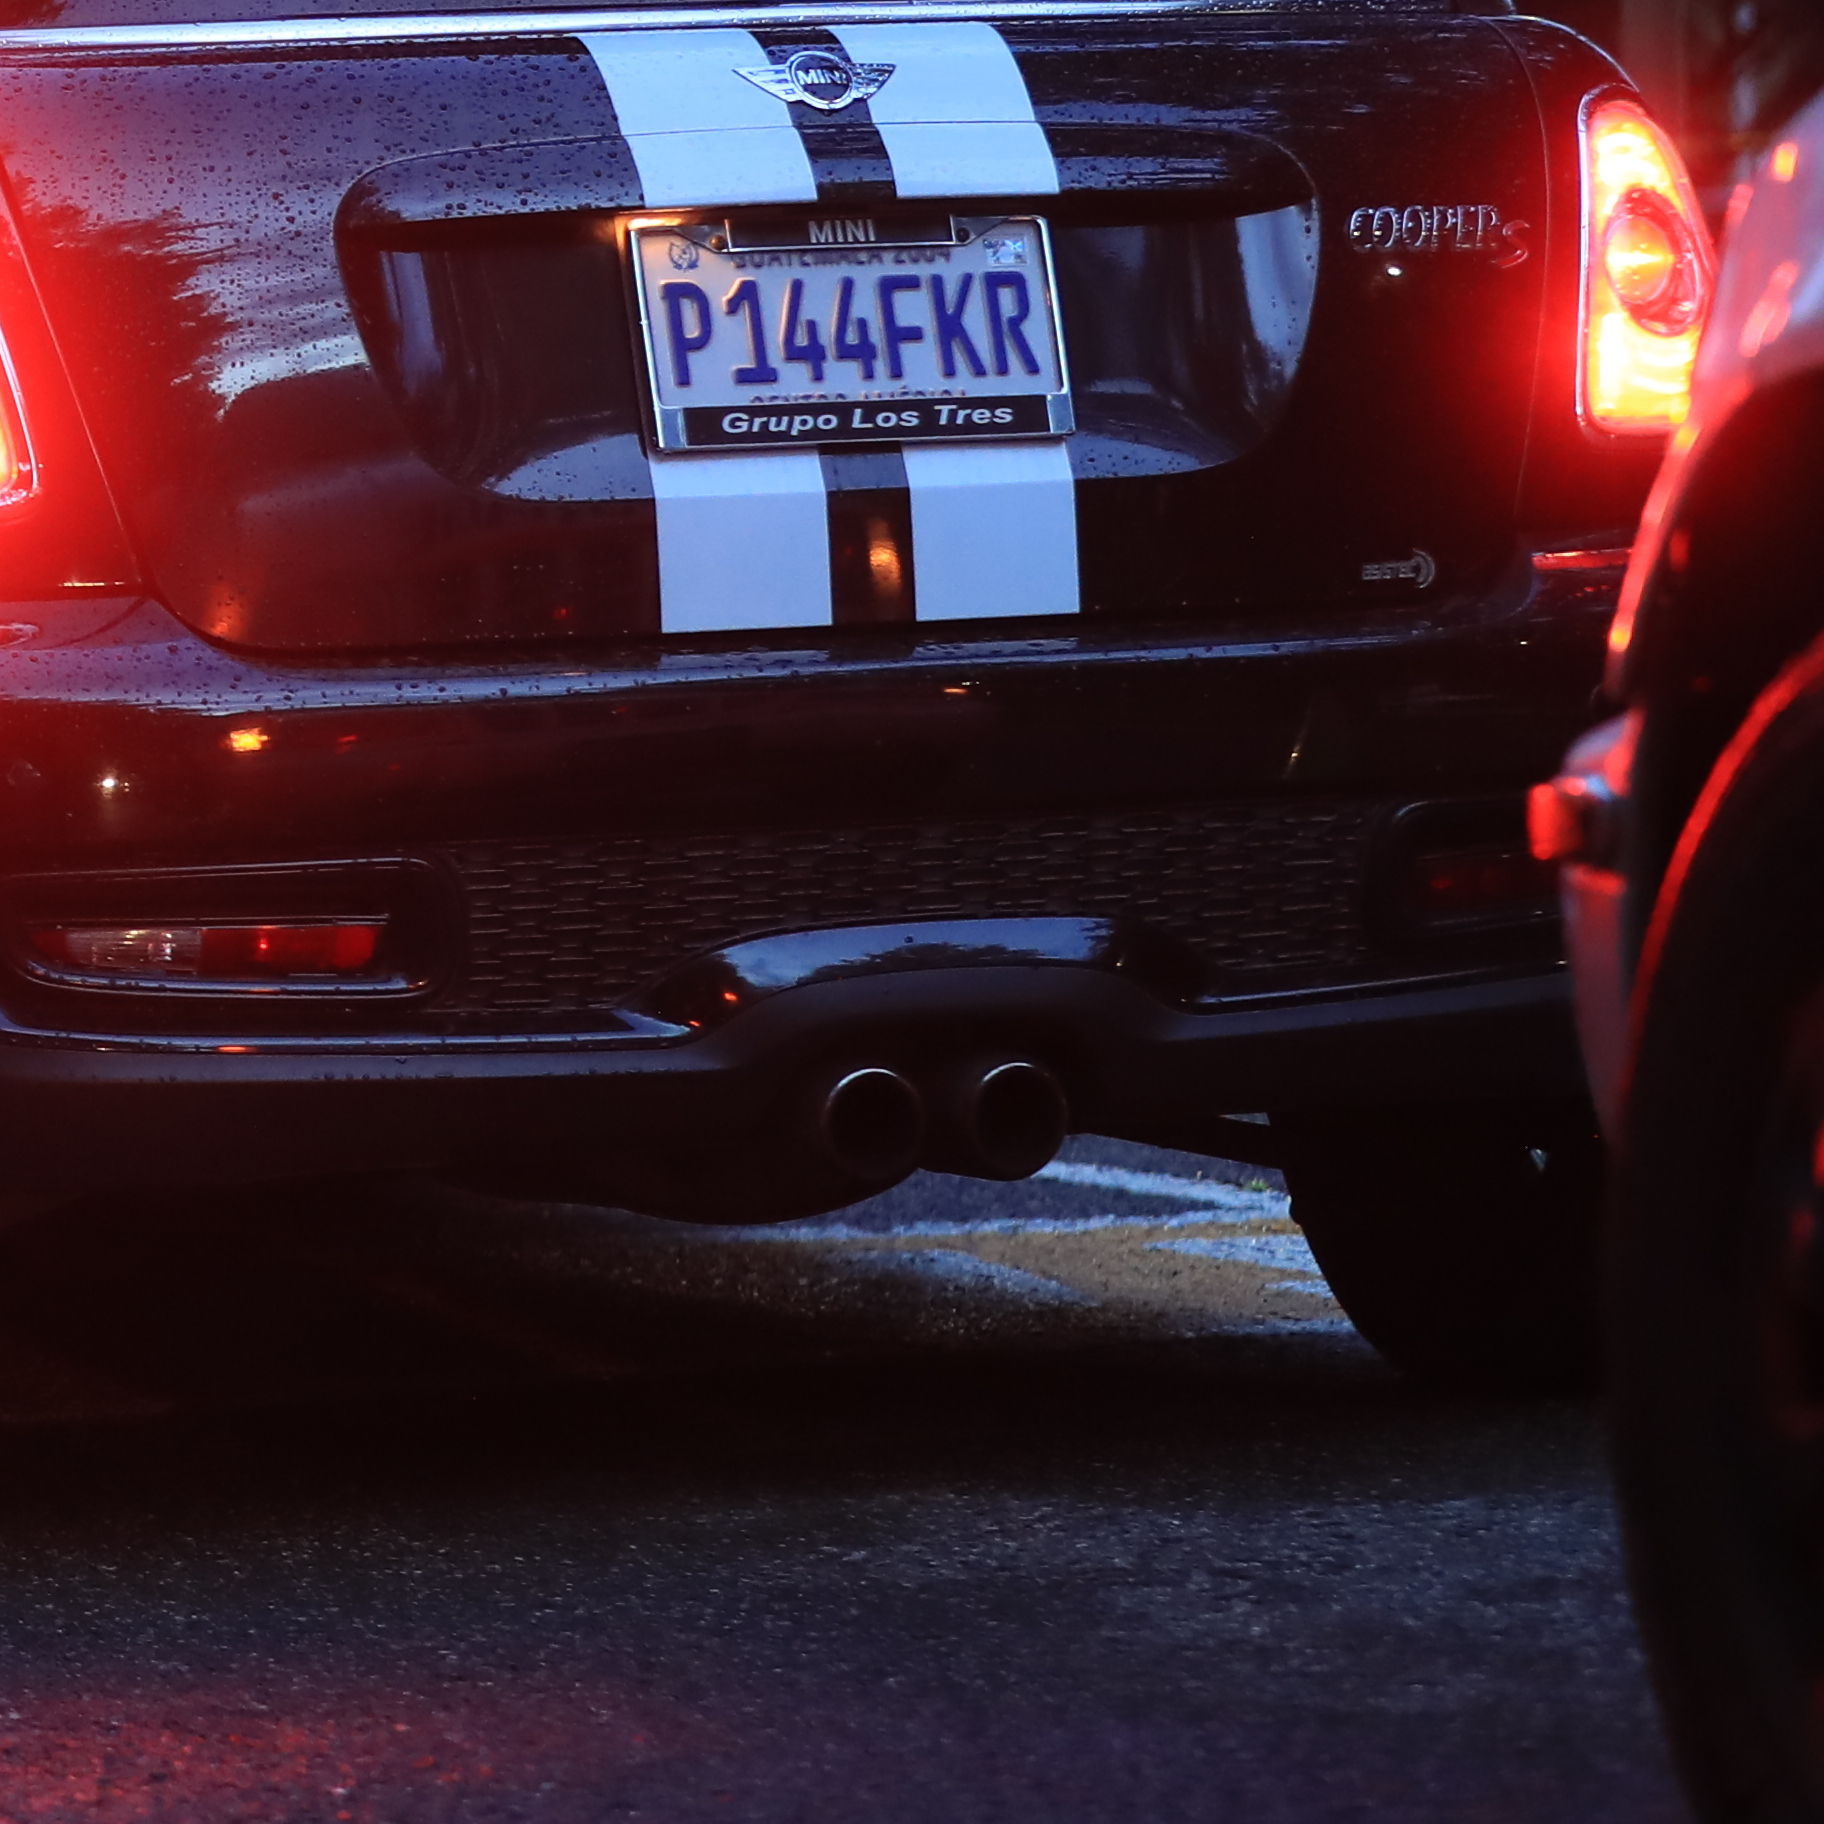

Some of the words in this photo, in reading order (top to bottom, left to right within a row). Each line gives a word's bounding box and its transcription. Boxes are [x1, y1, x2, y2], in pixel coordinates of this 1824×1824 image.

[796, 68, 848, 85] MINI
[808, 219, 876, 244] MINI
[1349, 204, 1500, 252] COOPER
[660, 271, 1041, 388] P144FKR
[721, 410, 839, 437] Grupo
[851, 407, 920, 428] Los
[933, 404, 1014, 425] Tres
